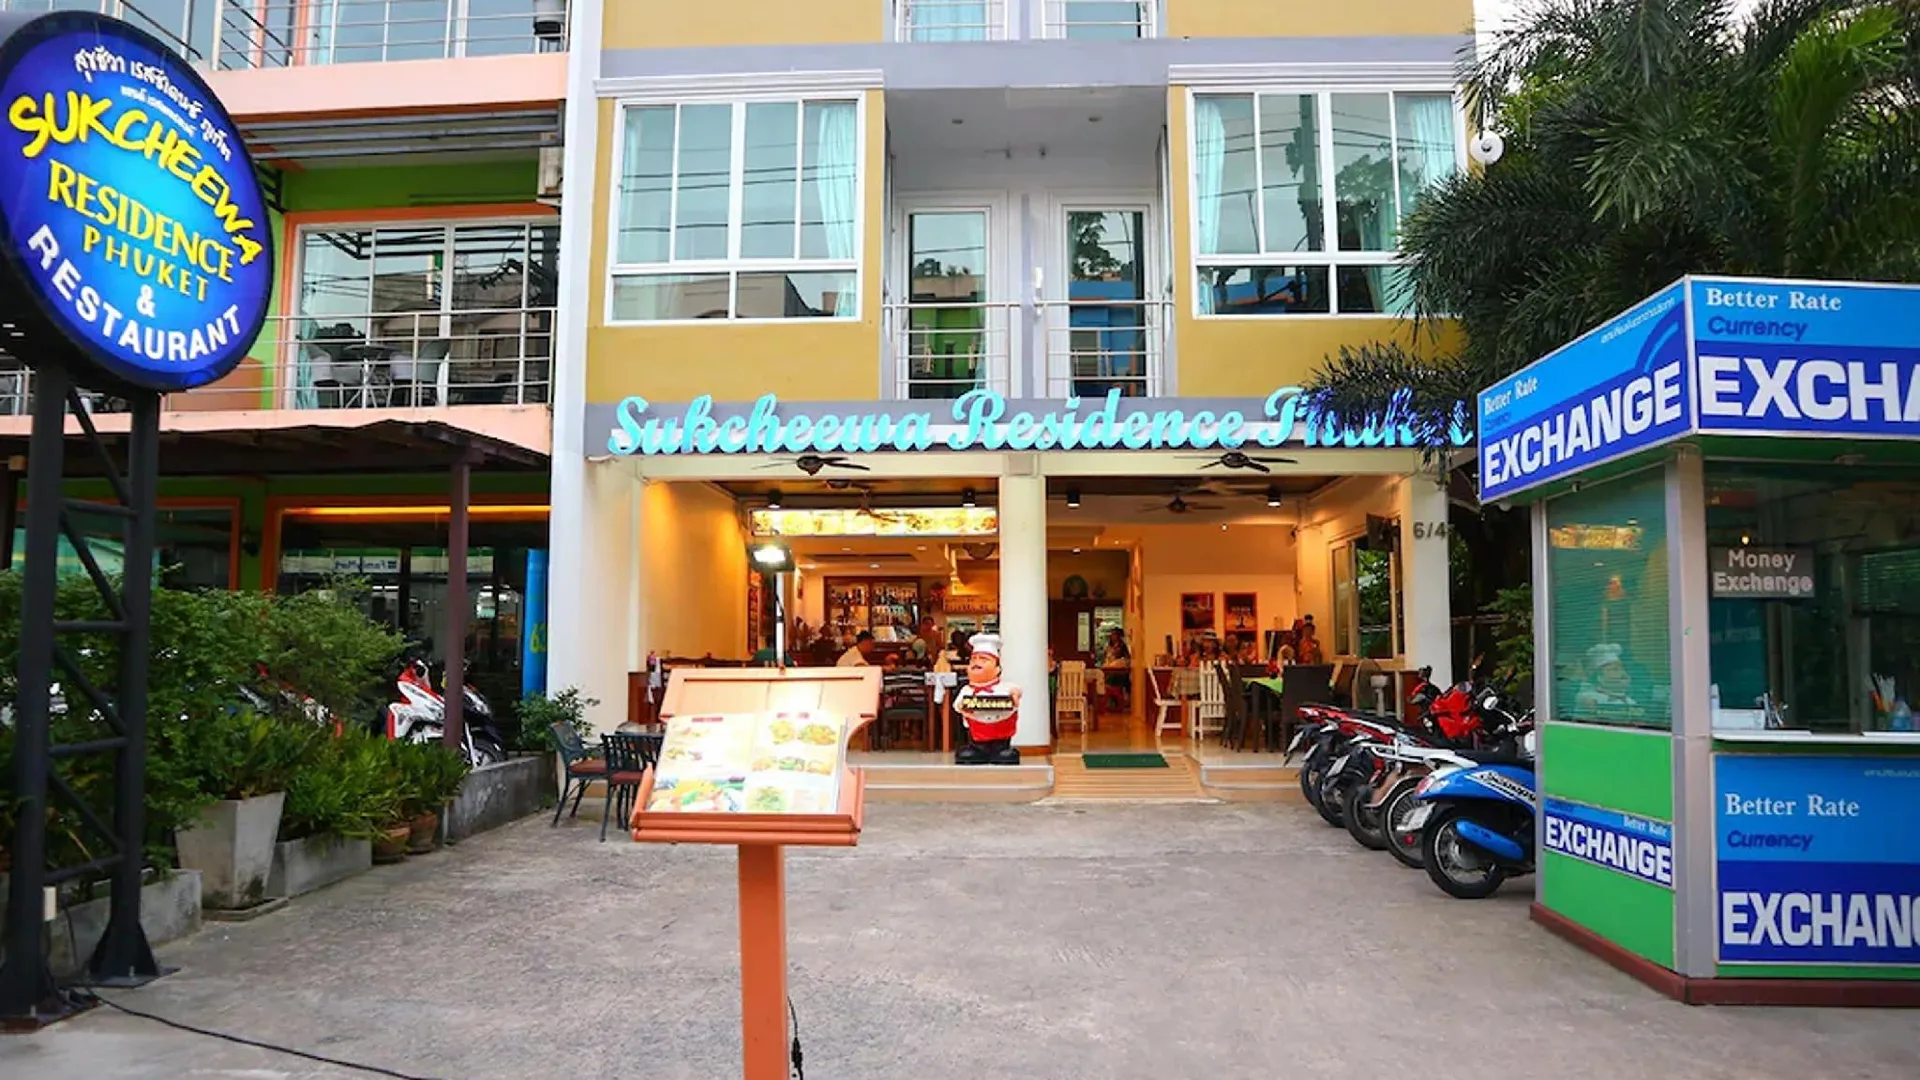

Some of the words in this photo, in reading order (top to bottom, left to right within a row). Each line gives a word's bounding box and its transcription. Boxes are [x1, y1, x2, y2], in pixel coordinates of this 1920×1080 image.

[8, 90, 264, 266] SUKCHEEWA
[48, 158, 236, 283] RESIDENCE
[83, 223, 209, 302] PHUKET
[27, 223, 240, 362] RESTAURANT
[135, 283, 156, 318] &
[1706, 287, 1779, 309] Better
[1789, 291, 1842, 311] Rate
[1708, 315, 1809, 341] Currency
[1484, 389, 1512, 416] Better
[1515, 376, 1539, 400] Rate
[608, 392, 935, 454] Sukcheewa
[945, 388, 1247, 450] Residence
[1484, 361, 1682, 490] EXCHANGE
[1713, 571, 1814, 596] Exchange
[1728, 549, 1796, 573] Money
[1725, 793, 1796, 815] Better
[1807, 794, 1860, 817] Rate
[1545, 815, 1672, 883] EXCHANGE
[1727, 830, 1813, 851] Currency
[1723, 891, 1920, 948] EXCHAN
